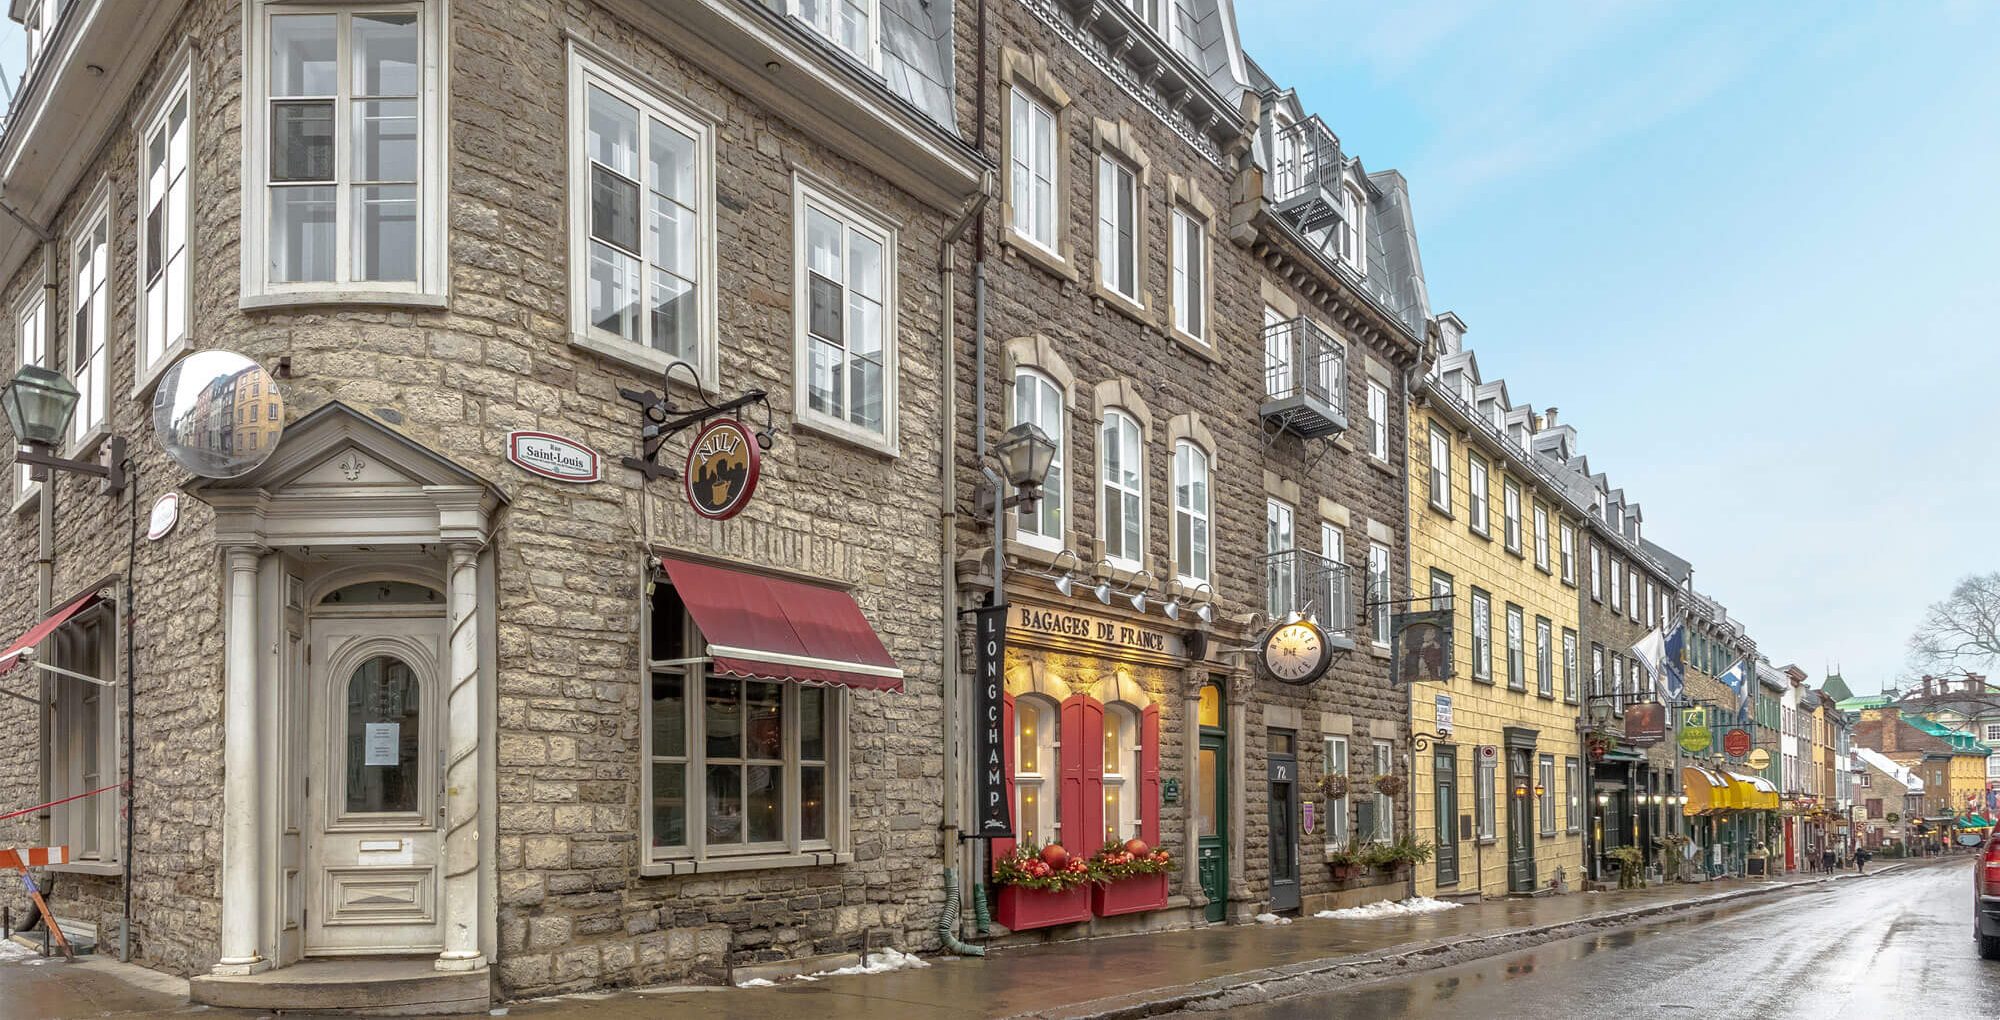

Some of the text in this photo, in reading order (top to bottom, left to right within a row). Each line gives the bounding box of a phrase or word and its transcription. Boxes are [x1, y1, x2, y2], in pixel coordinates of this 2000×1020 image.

[526, 445, 584, 468] Saint-Louis
[697, 432, 740, 465] NILI
[1021, 608, 1164, 651] BAGAGES DE FRANCE
[988, 618, 1000, 806] LONGCHAMP
[1276, 766, 1287, 779] 72
